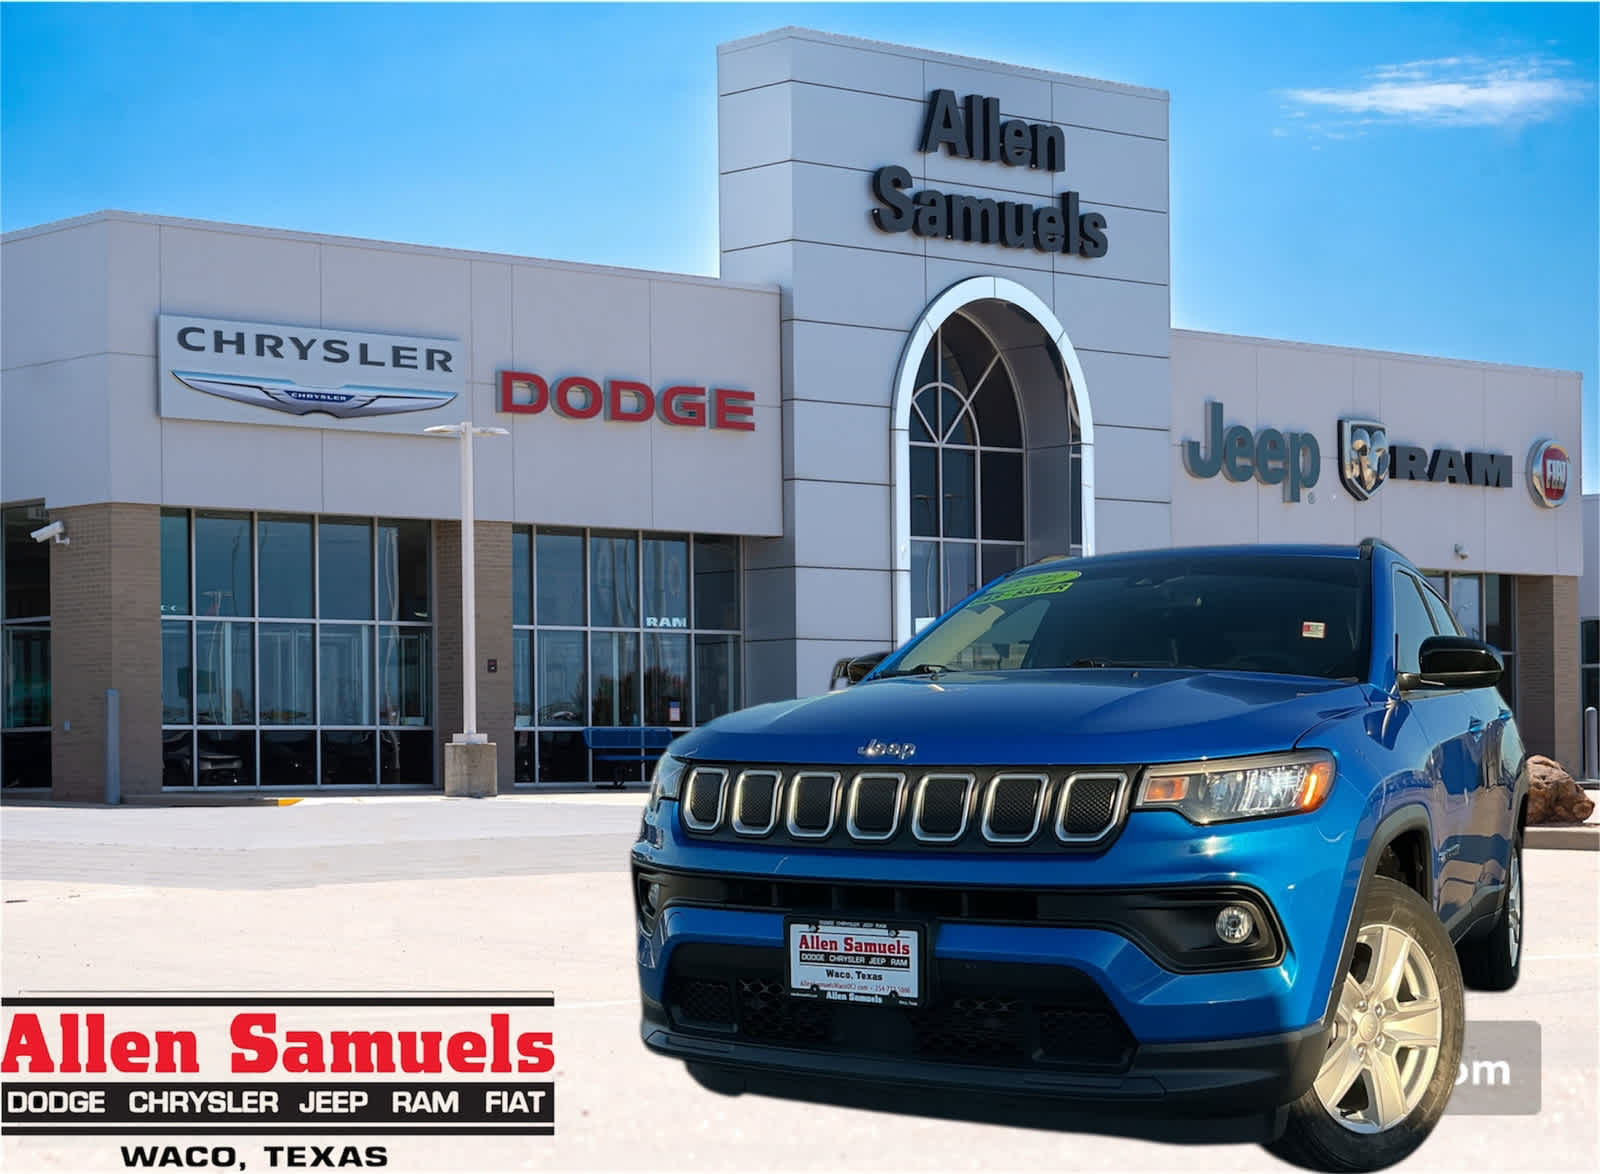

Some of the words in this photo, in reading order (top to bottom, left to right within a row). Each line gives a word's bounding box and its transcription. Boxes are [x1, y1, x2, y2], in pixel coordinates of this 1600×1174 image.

[918, 88, 1066, 172] Allen
[872, 165, 1109, 258] Samuels
[177, 326, 453, 372] CHRYSLER
[291, 391, 347, 401] CHRYSLER
[496, 370, 755, 431] DODGE
[1183, 401, 1321, 503] Jeep
[1389, 444, 1513, 488] RAM
[645, 616, 687, 627] RAM
[857, 738, 917, 760] Jeep
[799, 934, 838, 951] Allen
[843, 936, 910, 955] Samuels
[801, 953, 825, 962] DODGE
[828, 954, 865, 964] CHRYSLER
[868, 957, 887, 966] JEEP
[890, 958, 908, 967] RAM
[825, 968, 853, 979] Waco,
[855, 970, 883, 981] Texas
